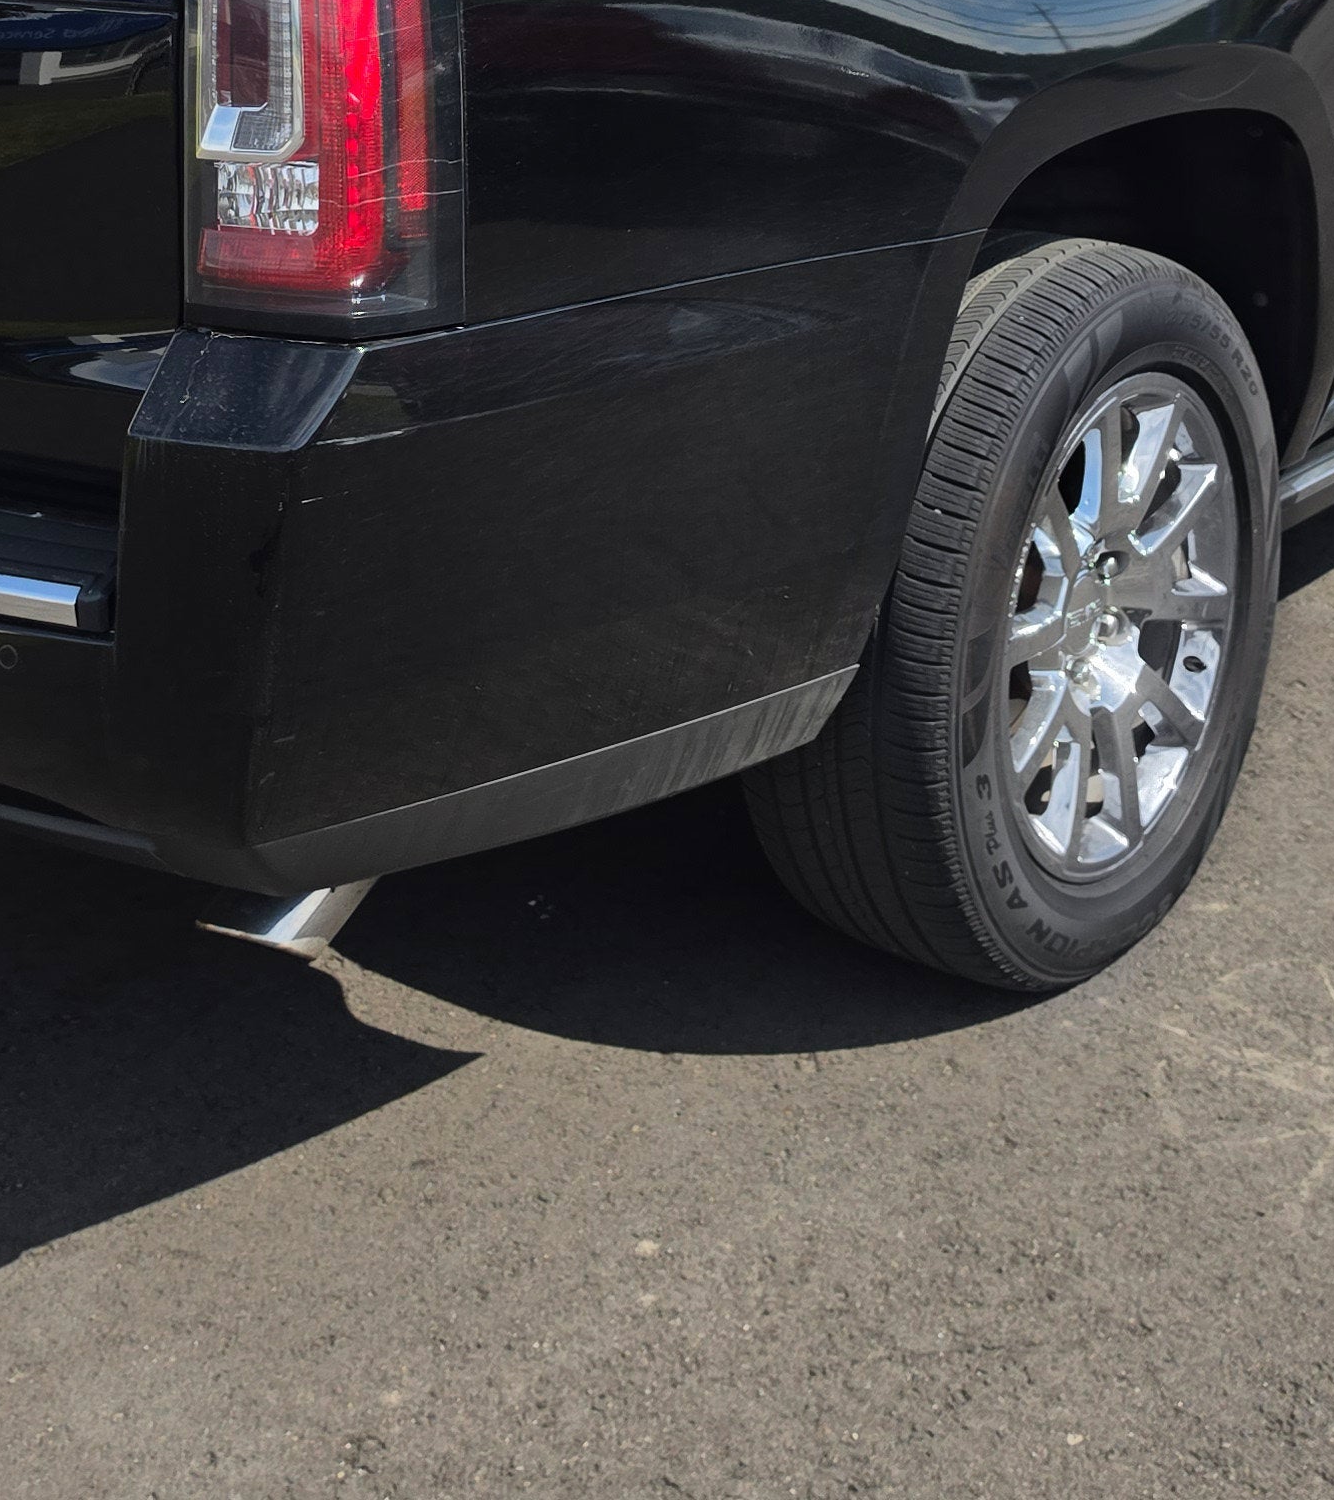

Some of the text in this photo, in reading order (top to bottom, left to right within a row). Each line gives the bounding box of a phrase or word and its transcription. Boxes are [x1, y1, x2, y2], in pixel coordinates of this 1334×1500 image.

[1232, 347, 1258, 396] R20
[975, 774, 992, 800] 3
[992, 860, 1028, 910] AS
